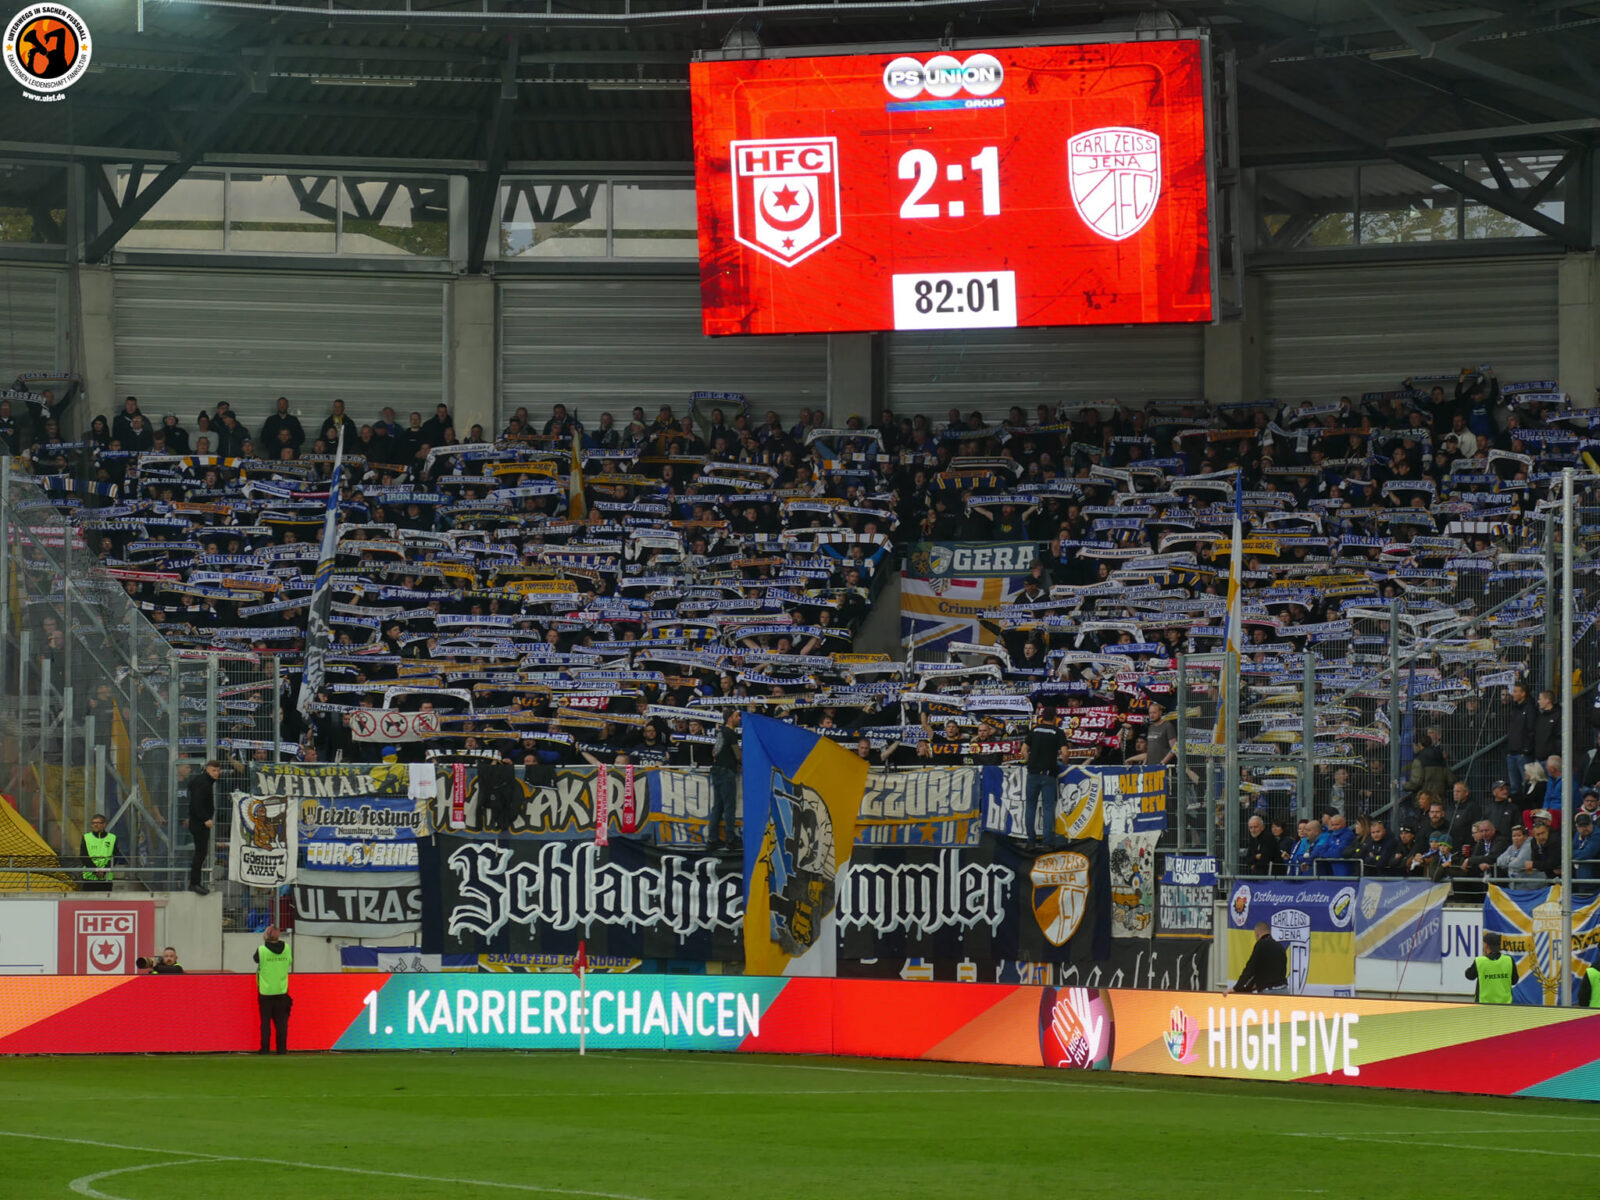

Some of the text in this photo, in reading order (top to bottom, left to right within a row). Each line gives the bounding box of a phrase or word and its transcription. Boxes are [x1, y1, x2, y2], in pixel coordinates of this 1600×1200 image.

[891, 67, 995, 86] PS UNION
[964, 98, 1004, 108] GROUP
[1075, 133, 1153, 154] CARL ZEISS
[744, 149, 824, 172] HFC
[1089, 154, 1142, 169] JENA
[898, 147, 1000, 218] 2:1
[1120, 173, 1153, 230] FC
[915, 278, 1000, 315] 82:01
[387, 493, 439, 502] IRON MIND
[953, 546, 1034, 572] GERA
[256, 771, 377, 798] WEIMAR
[315, 805, 421, 828] Letzte Festung
[246, 865, 278, 877] AWAY
[1043, 873, 1077, 884] JENA
[295, 887, 422, 922] ULTRAS
[1254, 890, 1330, 906] Ostbayern Chaoten
[82, 917, 130, 932] HFC
[1278, 930, 1302, 941] JENA
[487, 953, 559, 967] SAALFELD
[363, 989, 760, 1038] 1. KARRIERECHANCEN
[1068, 1026, 1082, 1055] HIGH
[1074, 1037, 1089, 1066] FIVE
[1208, 1006, 1360, 1077] HIGH FIVE
